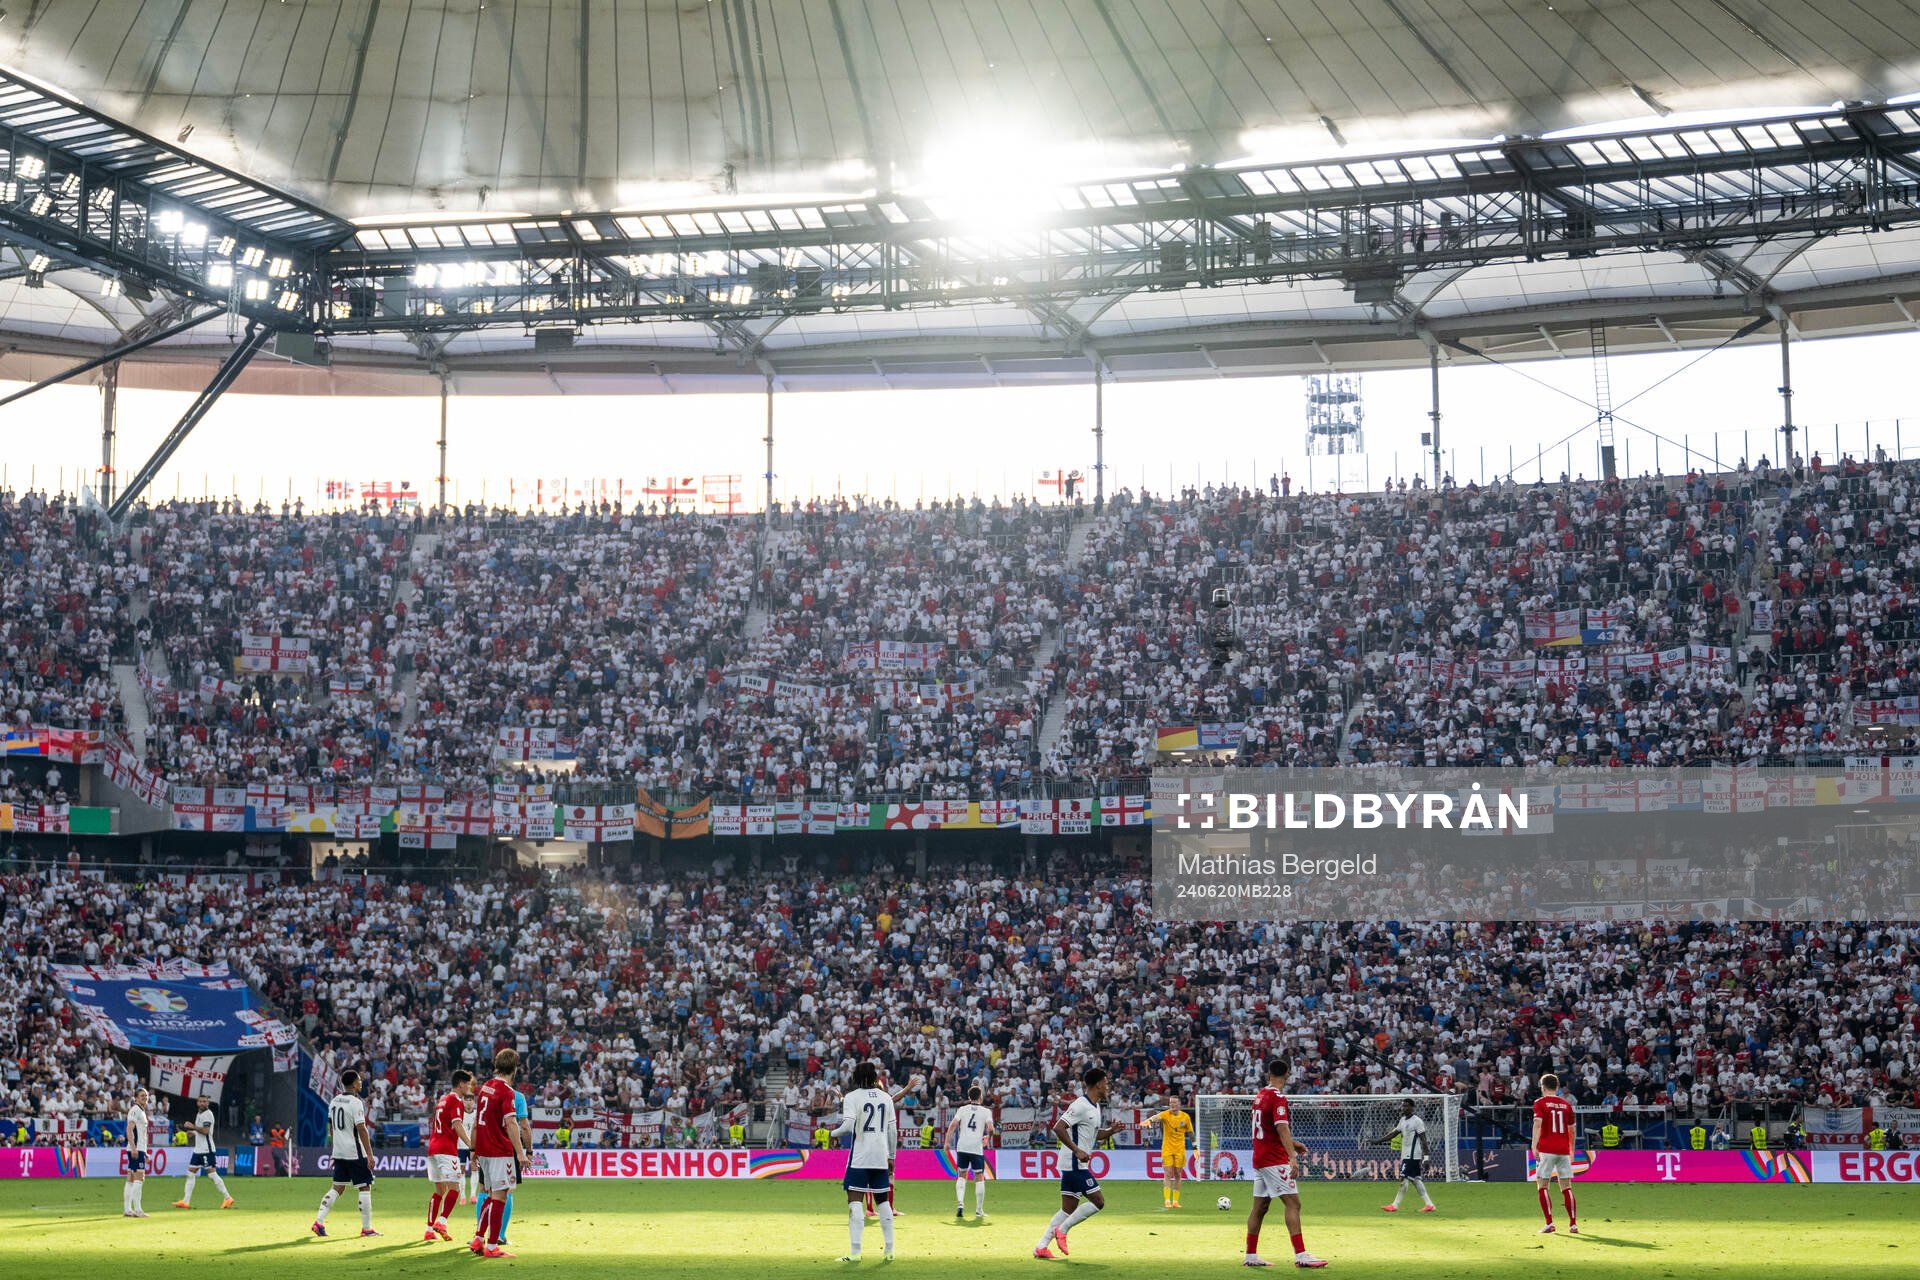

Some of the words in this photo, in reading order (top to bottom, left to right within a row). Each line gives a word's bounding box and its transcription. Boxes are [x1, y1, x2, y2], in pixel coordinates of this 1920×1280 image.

[1597, 632, 1614, 641] 43
[244, 649, 276, 657] BRISTOL
[606, 818, 632, 826] ROVERS
[1027, 812, 1086, 820] PRICELESS
[402, 837, 421, 845] CV3
[156, 1061, 224, 1080] HUDDERSFIELD
[331, 1106, 345, 1131] 10
[478, 1096, 488, 1126] 2
[863, 1102, 886, 1133] 21
[967, 1113, 977, 1132] 4
[1003, 1122, 1033, 1131] ROVERS
[1551, 1110, 1564, 1134] 11
[120, 1149, 166, 1175] EO
[562, 1151, 748, 1177] WIESENHOF
[1021, 1151, 1110, 1178] ERO
[1146, 1151, 1239, 1179] EGO
